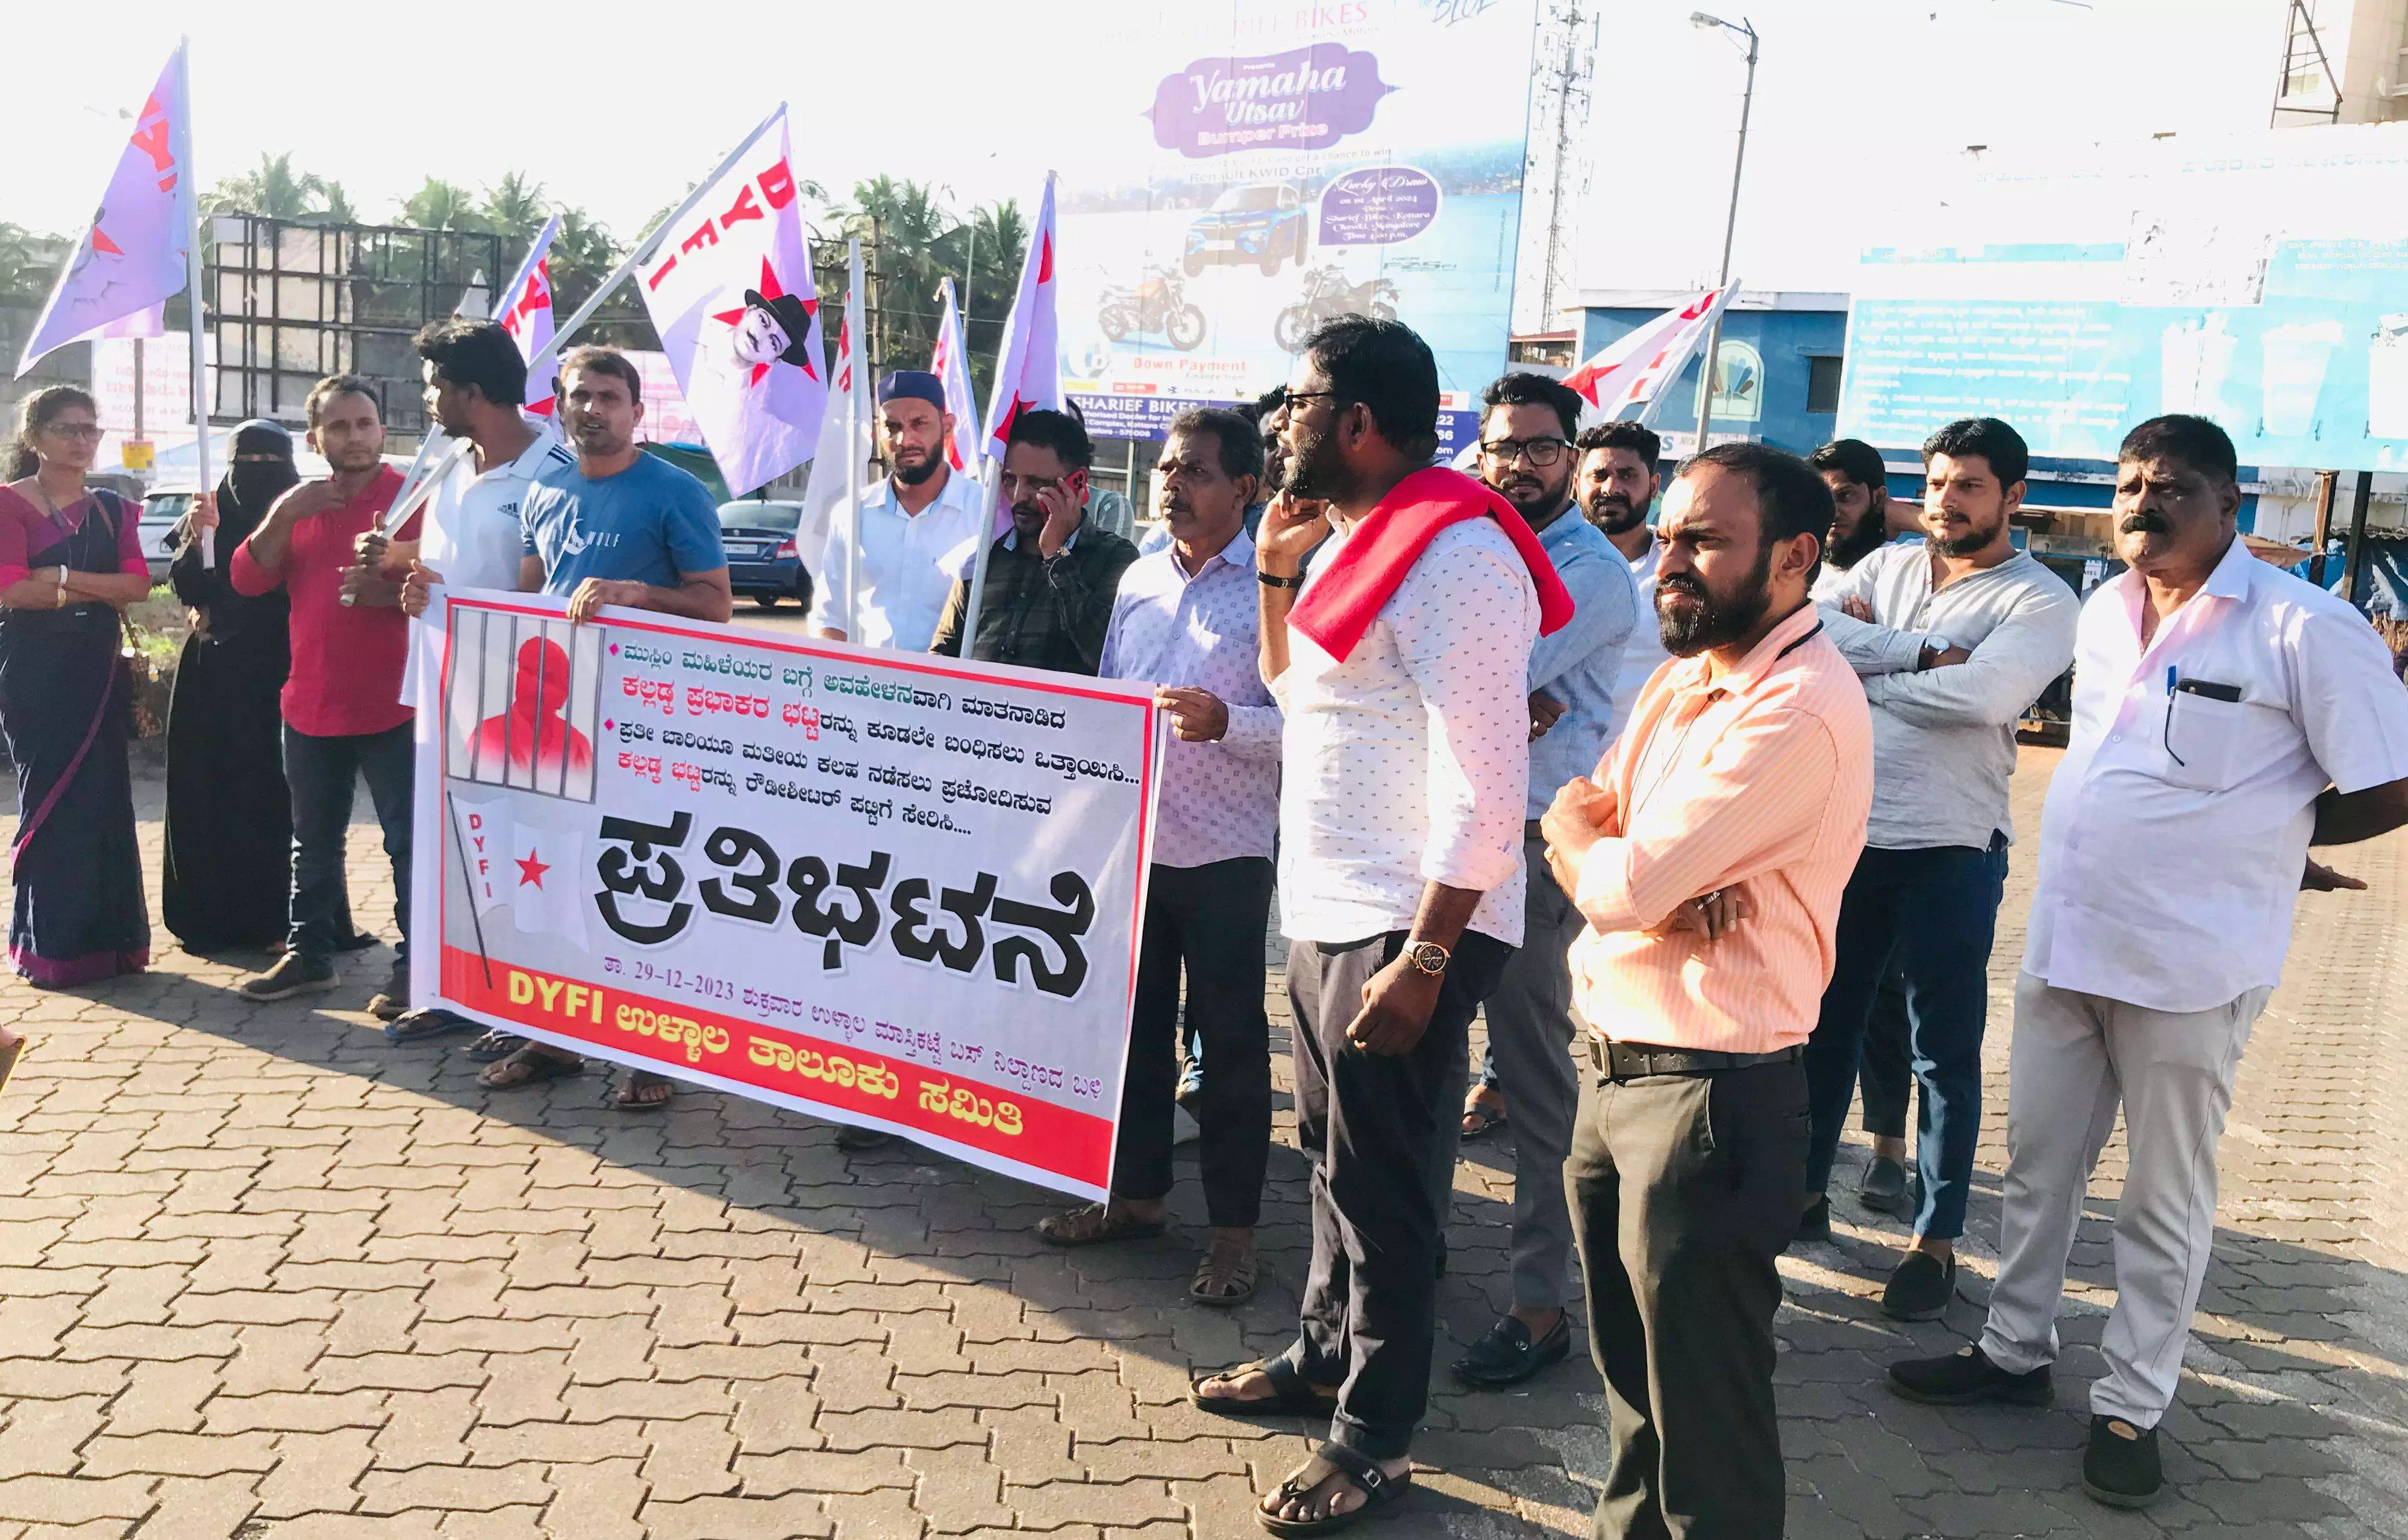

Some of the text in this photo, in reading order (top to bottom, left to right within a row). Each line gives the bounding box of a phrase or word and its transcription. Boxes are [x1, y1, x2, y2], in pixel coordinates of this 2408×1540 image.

[1295, 1, 1368, 29] BIKES
[1189, 60, 1347, 114] Yamaha
[1224, 99, 1305, 126] Utsav
[1198, 122, 1329, 145] Bumper Prize
[1322, 149, 1358, 160] chance
[1374, 148, 1391, 157] win
[1189, 166, 1323, 183] Renault KWID Car
[648, 155, 798, 293] DYFI
[1133, 357, 1246, 373] Down Payment
[1185, 372, 1220, 381] Finance
[1072, 396, 1144, 413] SHARIEF
[622, 673, 675, 715] ಕಲ್ಲಡ್ಕ
[687, 683, 771, 719] ಪ್ರಭಾಕರ
[782, 699, 858, 743] ಭಟ್ಟರನ್ನು
[867, 719, 935, 748] ಕೂಡಲೇ
[945, 735, 1025, 764] ಬಂಧಿಸಲು
[625, 643, 1066, 729] ಮುಸ್ಲಿಂ ಮಹಿಳೆಯರ ಬಗ್ಗೆ ಅವಹೇಳನವಾಗಿ ಮಾತನಾಡಿದ
[618, 750, 662, 784] ಕಲ್ಲಡ್ಕ
[671, 759, 737, 796] ಭಟ್ಟರನ್ನು
[850, 793, 893, 826] ಪಟ್ಟಿಗೆ
[619, 720, 1052, 815] ಪ್ರತೀ ಬಾರಿಯೂ ಮತೀಯ ಕಲಹ ನಡೆಸಲು ಪ್ರಚೋದಿಸುವ
[469, 814, 492, 898] DYFI
[594, 811, 1096, 999] ಪ್ರತಿಭಟನೆ
[508, 970, 1024, 1136] DYFI ಉಳ್ಳಾಲ ತಾಲೂಕು ಸಮಿತಿ
[604, 956, 1102, 1100] ತಾ. 29-12-2023 ಶುಕ್ರವಾರ ಉಳ್ಳಾಲ ಮಾಸ್ತಿಕಟ್ಟೆ ಬಸ್ ನಿಲ್ದಾಣದ ಬಳಿ
